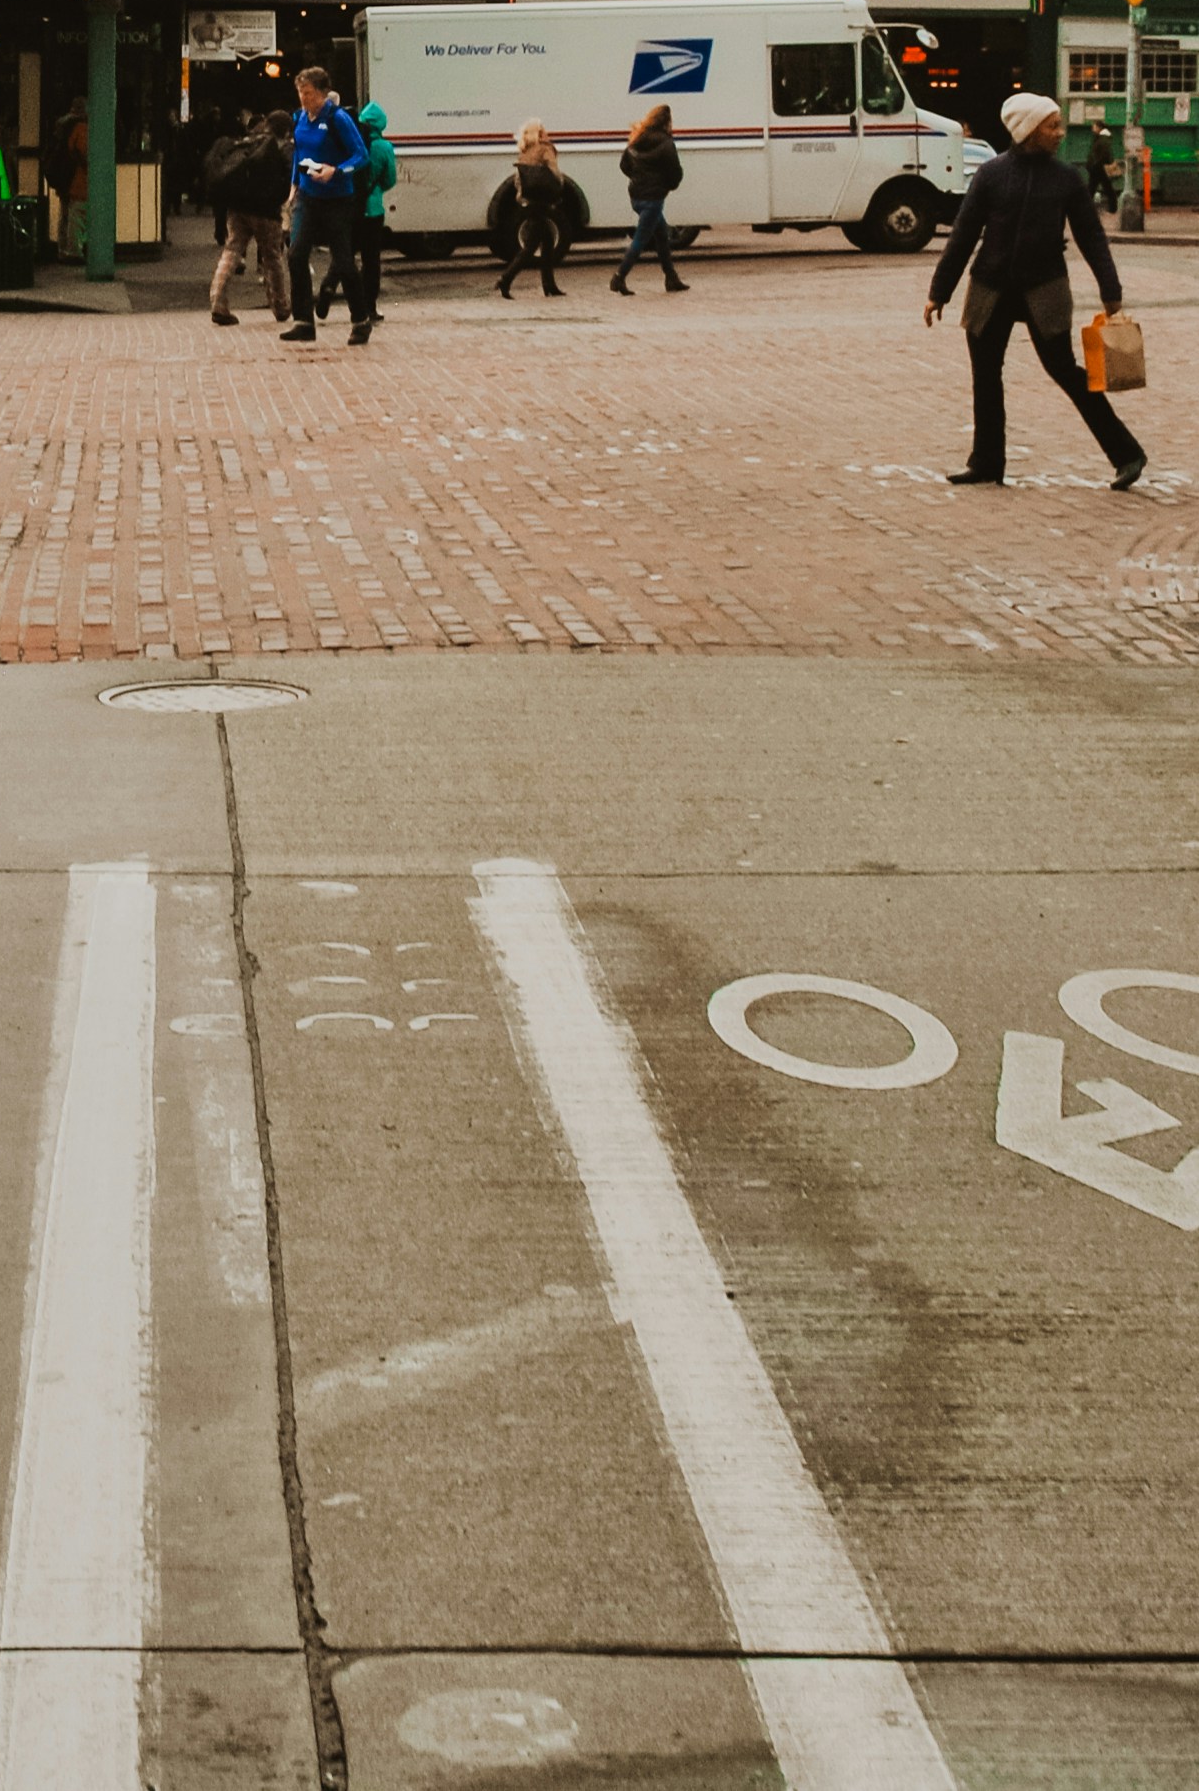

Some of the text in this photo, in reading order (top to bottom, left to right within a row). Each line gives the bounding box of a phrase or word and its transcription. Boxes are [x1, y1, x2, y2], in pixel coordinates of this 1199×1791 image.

[425, 44, 445, 56] We
[448, 43, 494, 56] Deliver
[497, 43, 518, 55] For
